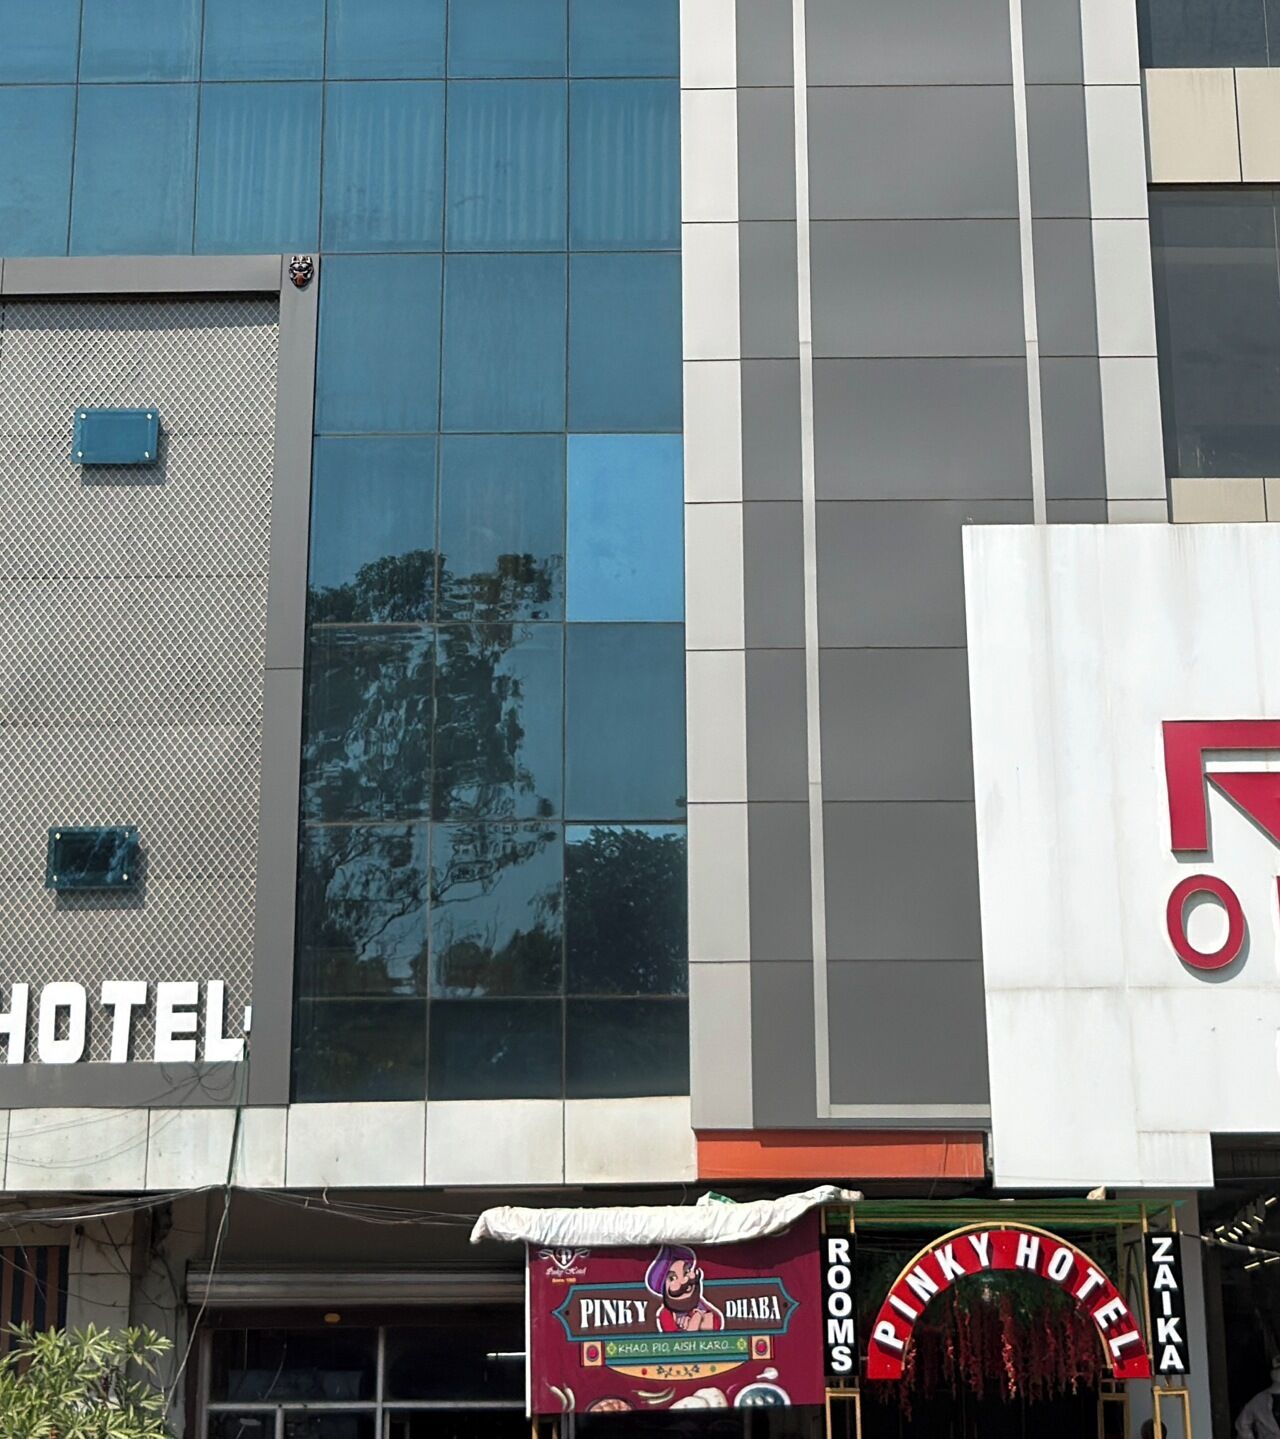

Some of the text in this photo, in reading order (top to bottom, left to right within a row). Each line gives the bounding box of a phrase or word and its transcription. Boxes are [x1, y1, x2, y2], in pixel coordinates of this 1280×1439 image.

[579, 1295, 781, 1328] PINKY DHABA
[673, 1341, 697, 1352] AISH
[827, 1238, 855, 1373] ROOMS
[873, 1231, 1141, 1359] PINKY HOTEL
[1151, 1236, 1185, 1371] ZAIKA
